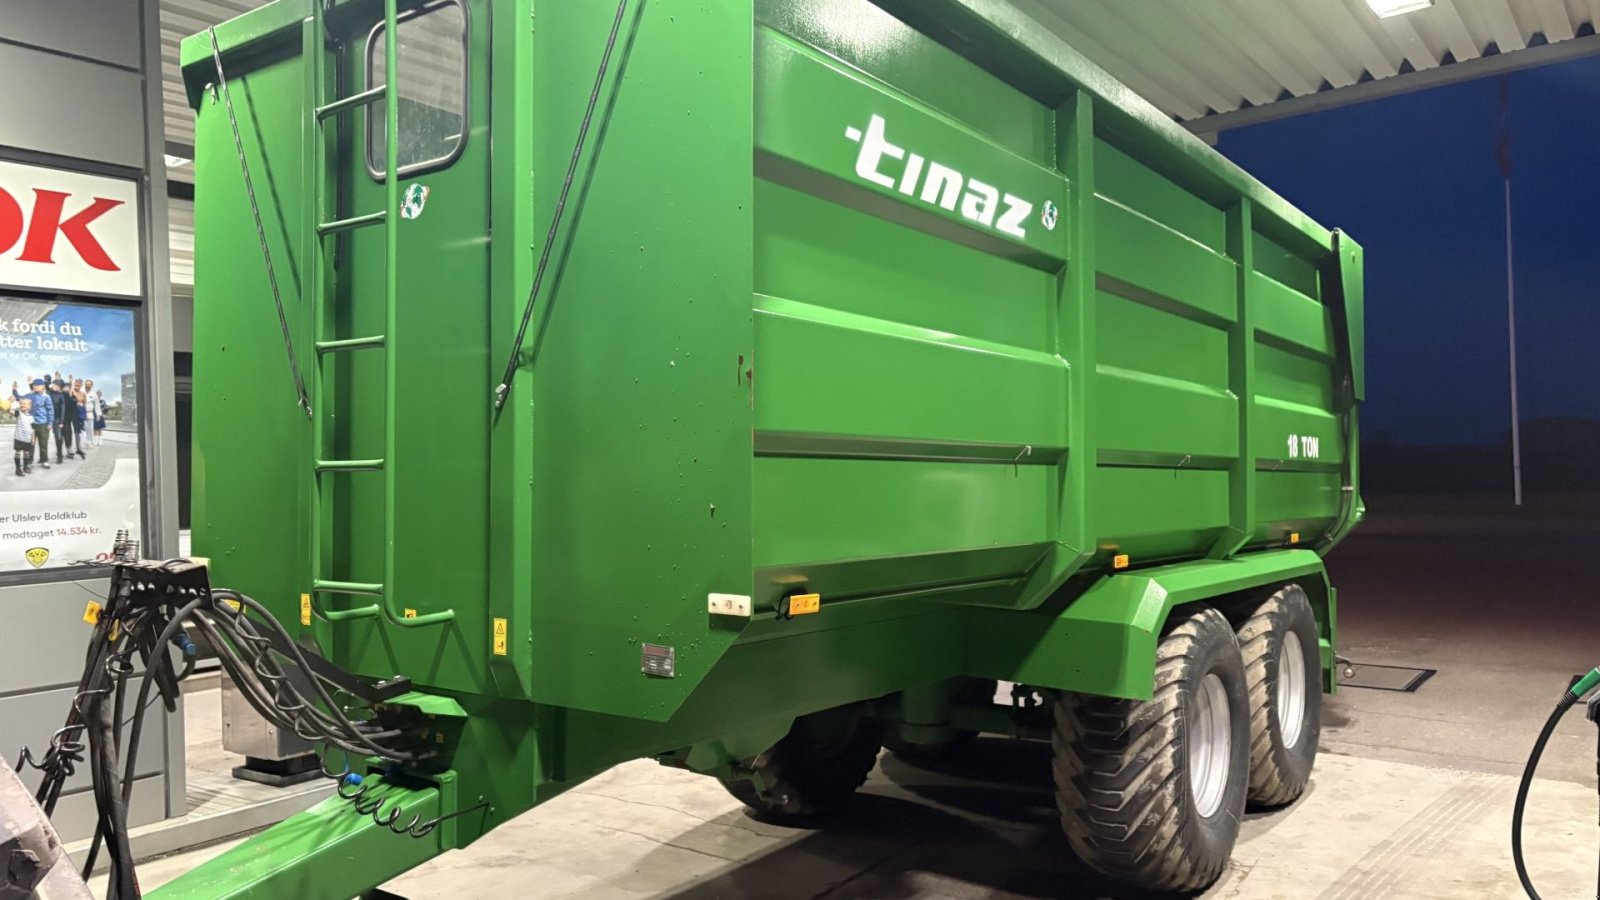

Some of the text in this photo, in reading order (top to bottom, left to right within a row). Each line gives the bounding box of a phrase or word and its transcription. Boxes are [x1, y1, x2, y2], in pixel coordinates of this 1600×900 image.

[12, 319, 56, 334] fordi
[60, 322, 83, 336] du
[36, 336, 88, 352] lokalt
[22, 351, 38, 360] OK
[1287, 434, 1319, 458] 18 TON
[12, 513, 42, 522] Ulslev
[45, 511, 87, 521] Boldklub
[3, 526, 102, 540] modtaget 14.534 kr.
